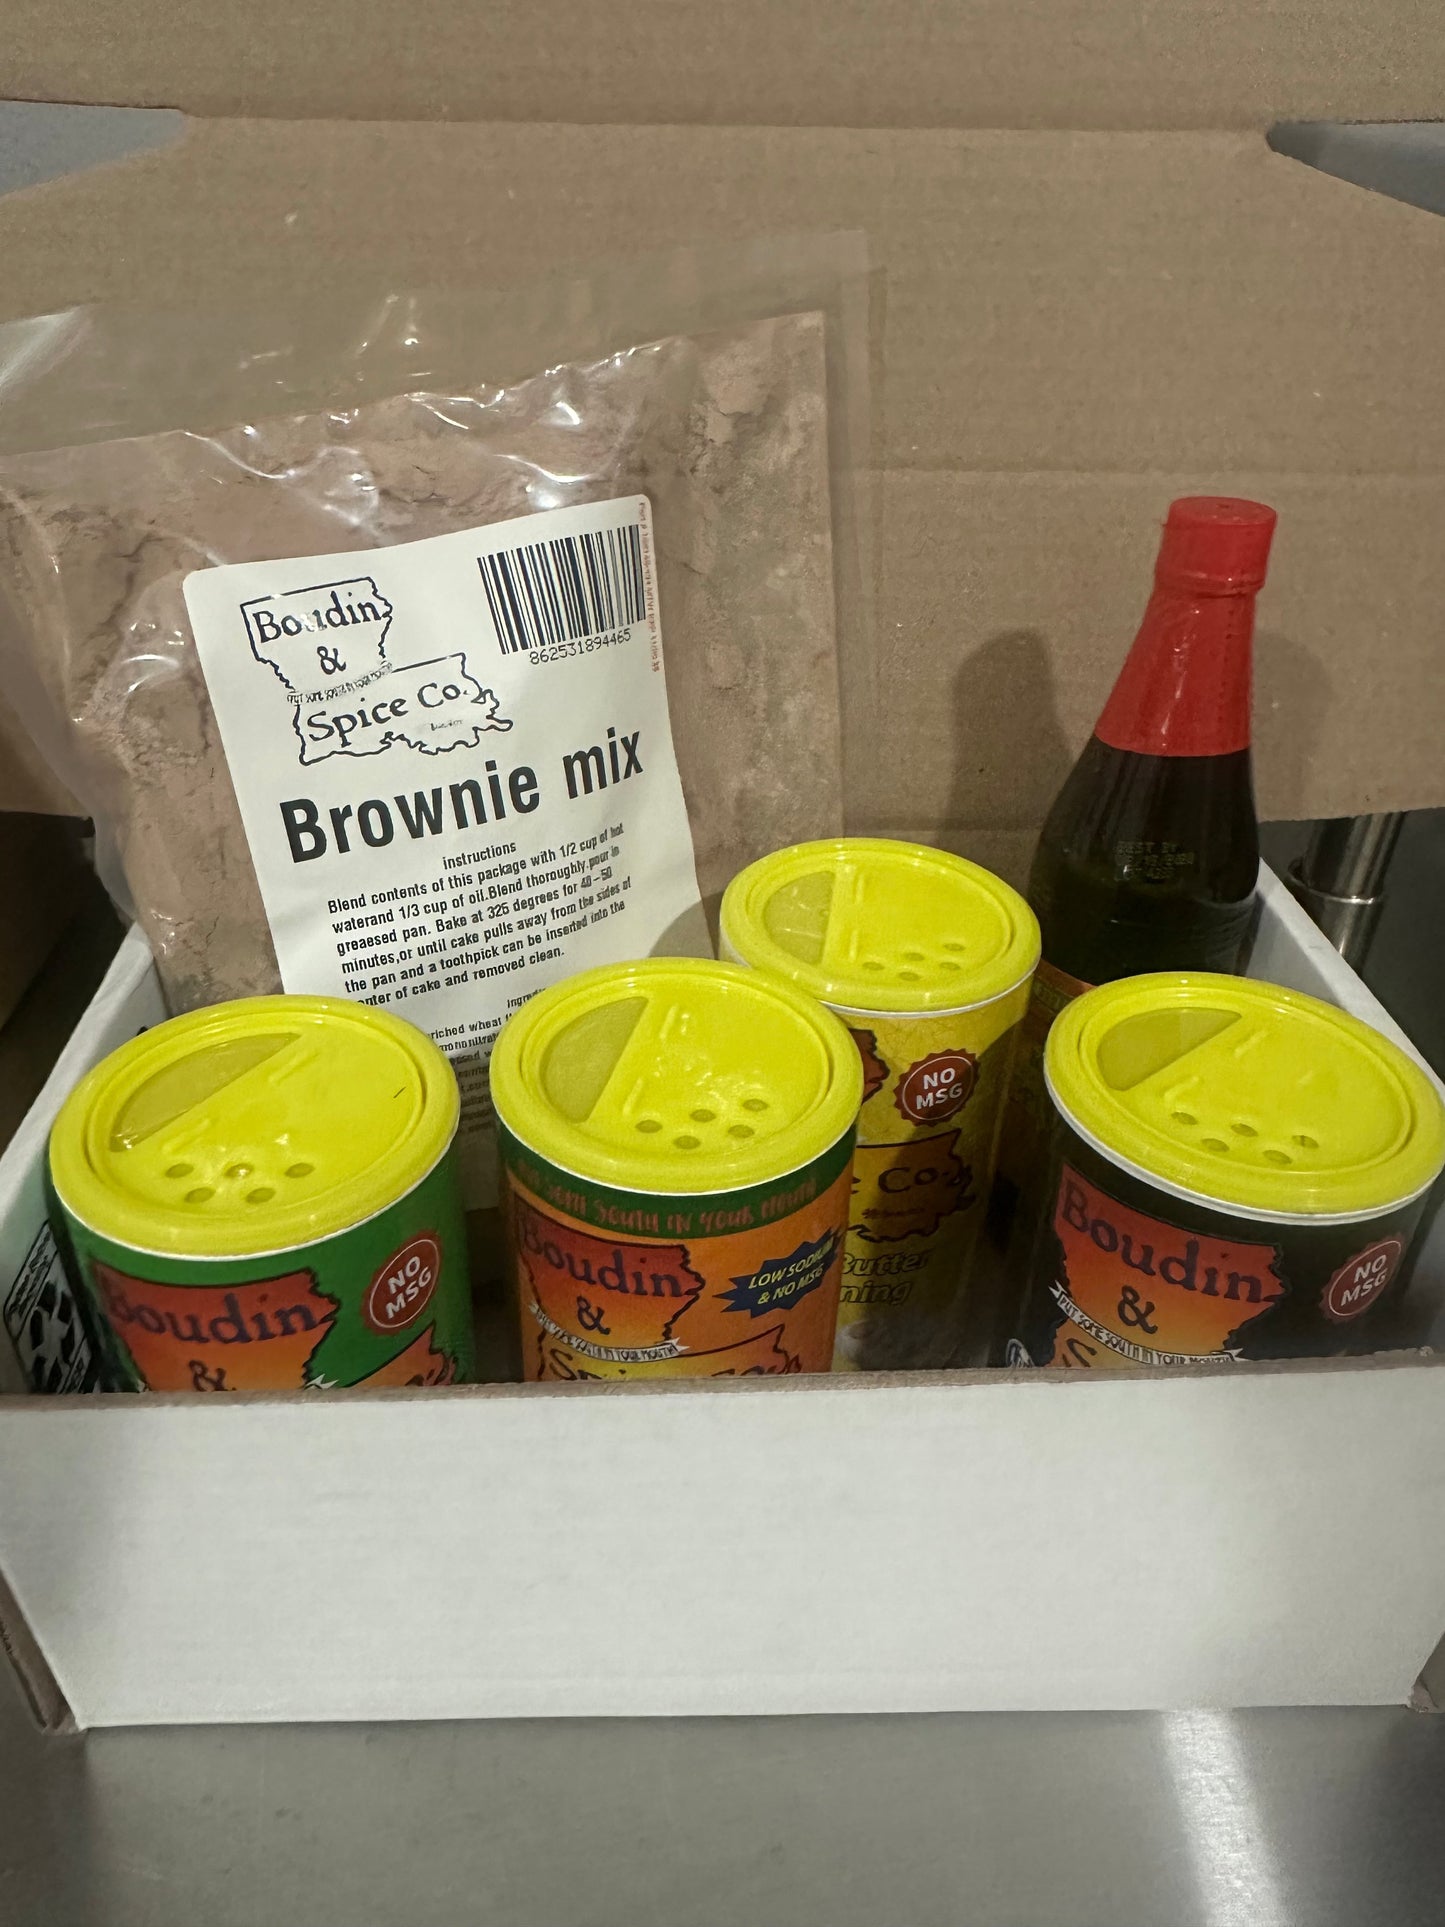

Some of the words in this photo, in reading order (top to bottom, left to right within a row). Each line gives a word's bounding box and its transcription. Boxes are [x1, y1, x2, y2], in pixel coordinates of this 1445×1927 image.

[253, 591, 382, 643] Boudin
[316, 646, 347, 675] &
[529, 628, 632, 665] 862531894465
[307, 697, 408, 747] Spice
[417, 683, 470, 708] Co.
[279, 759, 540, 863] Brownie
[562, 727, 644, 799] mix
[327, 894, 367, 914] Blend
[371, 883, 427, 904] contents
[432, 878, 445, 892] of
[448, 873, 473, 889] this
[477, 859, 527, 885] package
[530, 849, 556, 867] with
[559, 842, 577, 857] 1/2
[580, 836, 597, 851] cup
[600, 829, 608, 843] of
[442, 842, 517, 870] instructions
[399, 904, 420, 919] 1/3
[424, 900, 448, 914] cup
[452, 894, 465, 908] of
[402, 926, 432, 942] pan.
[436, 916, 467, 932] Bake
[472, 910, 484, 923] at
[513, 889, 559, 912] degrees
[563, 883, 578, 896] for
[417, 939, 447, 957] until
[451, 933, 479, 949] cake
[484, 922, 514, 943] pulls
[517, 912, 547, 931] away
[551, 904, 577, 920] from
[579, 895, 594, 910] the
[597, 884, 620, 902] sides
[345, 980, 367, 993] the
[372, 973, 396, 990] pan
[401, 964, 424, 980] and
[429, 963, 437, 973] a
[440, 945, 500, 970] toothpick
[503, 940, 523, 957] can
[528, 934, 542, 947] be
[546, 916, 588, 941] inserted
[591, 909, 609, 924] into
[610, 900, 626, 915] the
[396, 986, 407, 1000] of
[412, 979, 441, 994] cake
[445, 971, 468, 986] and
[473, 956, 525, 980] removed
[529, 945, 565, 964] clean.
[427, 1024, 465, 1040] riched
[469, 1017, 502, 1032] wheat
[916, 1082, 963, 1110] MSG
[922, 1067, 956, 1091] NO
[524, 1223, 683, 1297] Boudin
[1061, 1179, 1265, 1303] Boudin
[388, 1256, 420, 1295] NO
[748, 1267, 787, 1289] LOW
[757, 1291, 770, 1305] &
[772, 1282, 796, 1300] NO
[796, 1262, 824, 1290] MSG
[1340, 1267, 1388, 1307] MSG
[1354, 1254, 1387, 1283] NO
[385, 1265, 431, 1319] MSG
[1117, 1285, 1158, 1334] &
[576, 1295, 611, 1335] &
[188, 1359, 237, 1391] &
